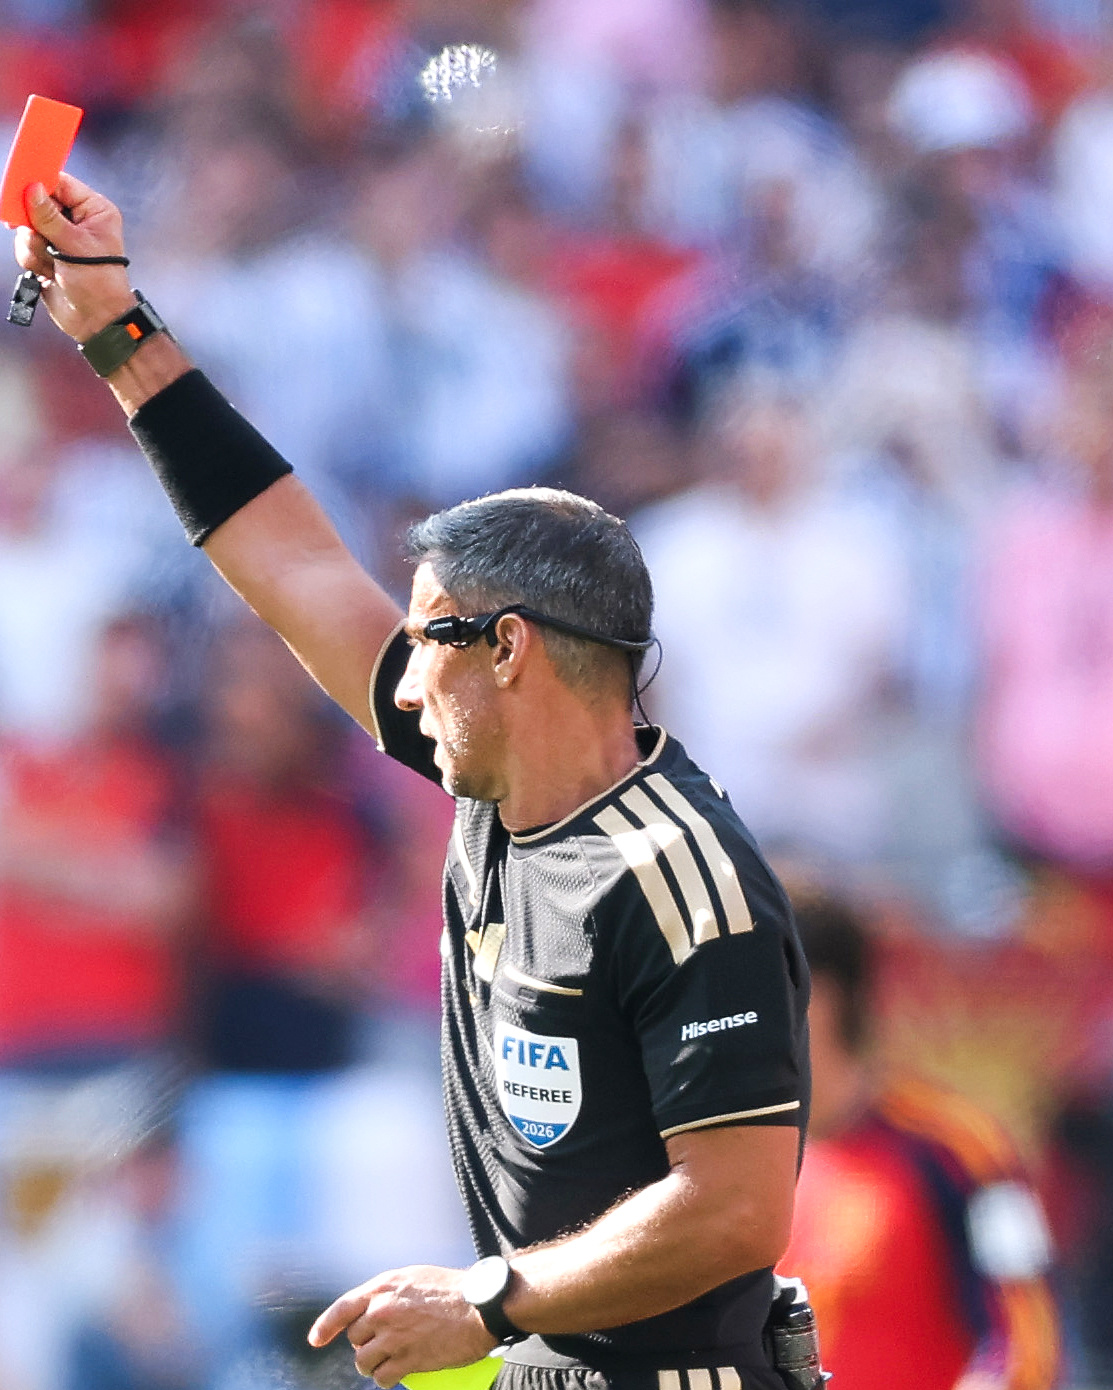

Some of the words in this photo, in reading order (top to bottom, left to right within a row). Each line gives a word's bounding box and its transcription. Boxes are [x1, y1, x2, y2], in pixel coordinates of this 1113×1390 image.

[681, 1011, 758, 1041] Hisense
[502, 1036, 570, 1071] FIFA
[503, 1080, 573, 1104] REFEREE
[521, 1121, 555, 1138] 2026
